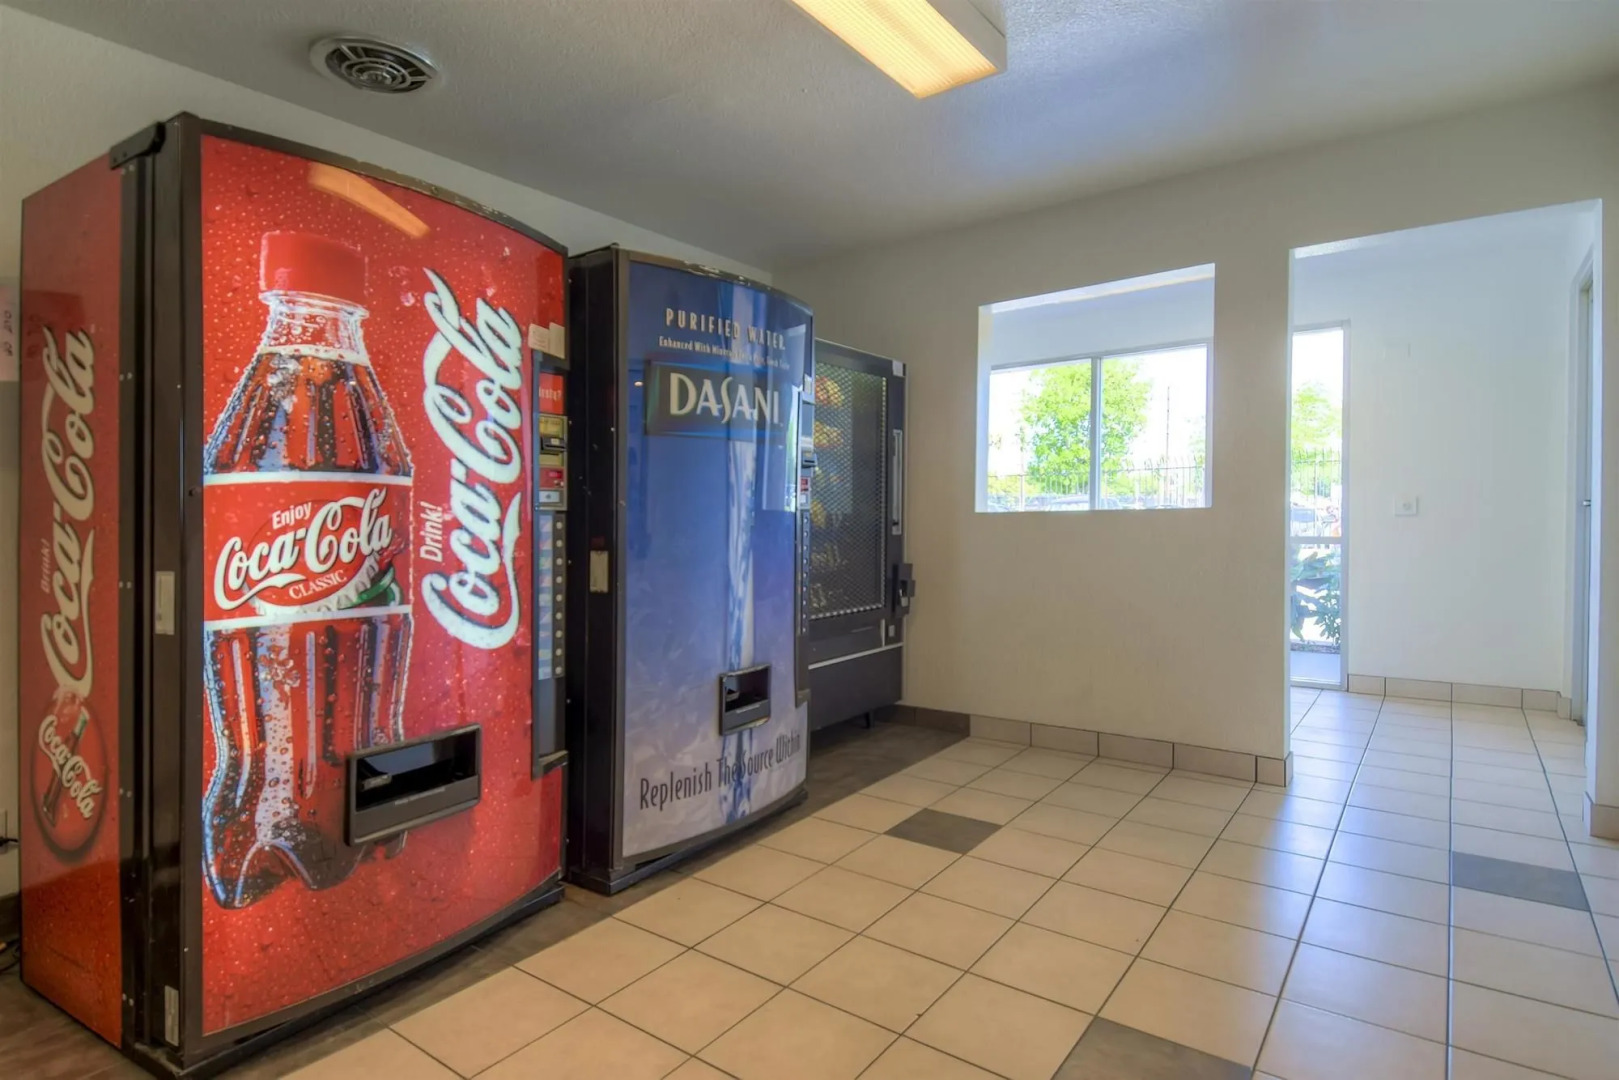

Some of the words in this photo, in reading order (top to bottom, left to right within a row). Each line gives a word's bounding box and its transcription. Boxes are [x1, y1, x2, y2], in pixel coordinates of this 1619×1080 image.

[659, 335, 694, 352] Enhanced
[694, 341, 711, 355] With
[665, 307, 741, 339] PURIFIED
[747, 324, 786, 351] WATER
[669, 371, 779, 425] DASANI
[421, 267, 523, 649] Coca-Cola
[41, 325, 95, 695] Coca-Cola
[272, 502, 312, 530] Enjoy
[419, 501, 443, 562] Drink!
[214, 487, 393, 610] Coca-Cola
[288, 570, 347, 599] CLASSIC
[39, 714, 103, 819] Coca-Cola
[640, 761, 712, 812] Replenish
[716, 757, 738, 788] The
[740, 748, 774, 778] Source
[775, 729, 800, 764] Within
